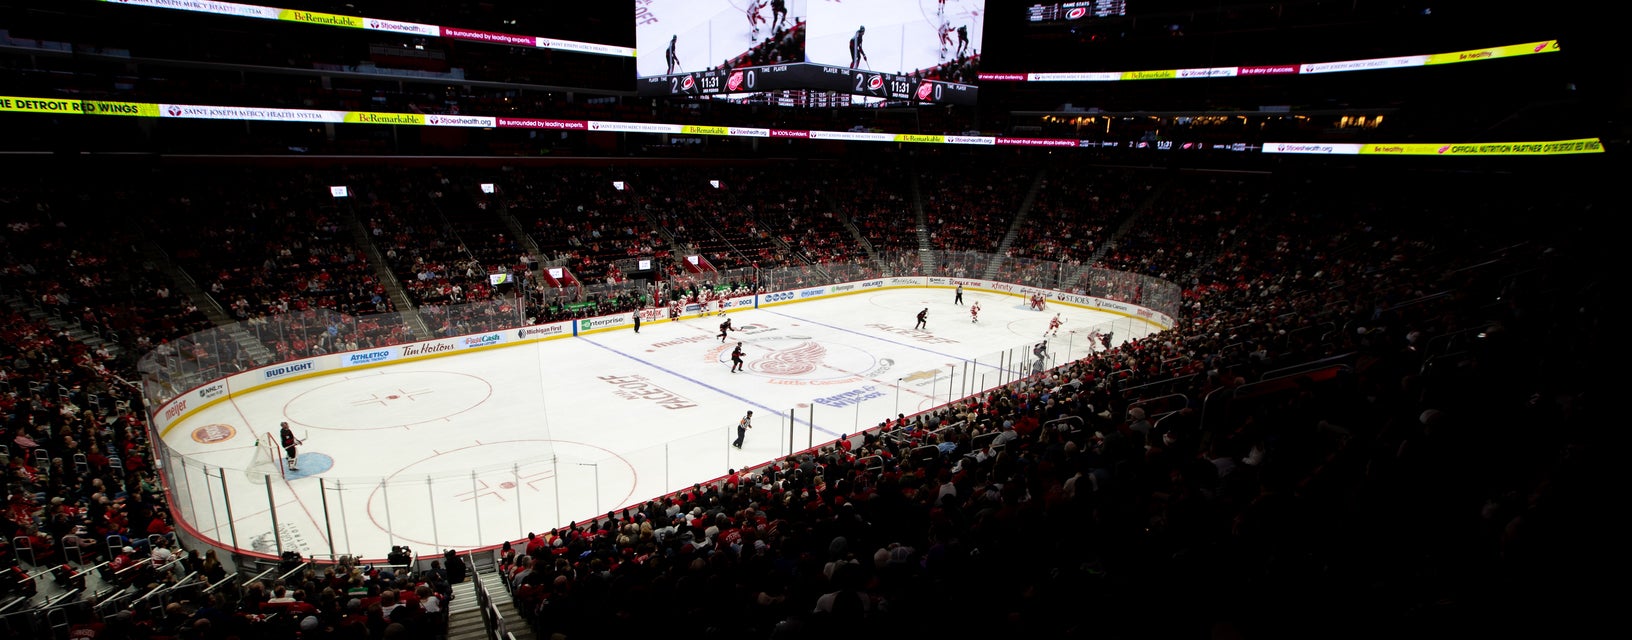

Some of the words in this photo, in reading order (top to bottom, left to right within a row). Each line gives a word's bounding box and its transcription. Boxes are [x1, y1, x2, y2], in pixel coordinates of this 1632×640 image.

[454, 30, 483, 39] surrounded
[484, 33, 491, 41] by
[492, 34, 511, 43] leading
[671, 77, 678, 93] 2
[701, 77, 719, 88] 11:31
[747, 70, 755, 88] 0
[856, 73, 863, 91] 2
[891, 82, 909, 93] 11:31
[935, 84, 942, 100] 0
[17, 99, 68, 111] DETROIT
[73, 102, 95, 112] RED
[98, 103, 138, 114] WINGS
[545, 121, 564, 129] leading
[991, 283, 1013, 292] xfinity
[526, 326, 549, 335] Michigan
[550, 325, 562, 333] First
[351, 350, 389, 362] ATHLETICO
[402, 344, 419, 357] Tim
[420, 343, 454, 355] Hortons
[266, 368, 285, 378] BUD
[286, 363, 312, 375] LIGHT
[165, 399, 187, 421] meijer
